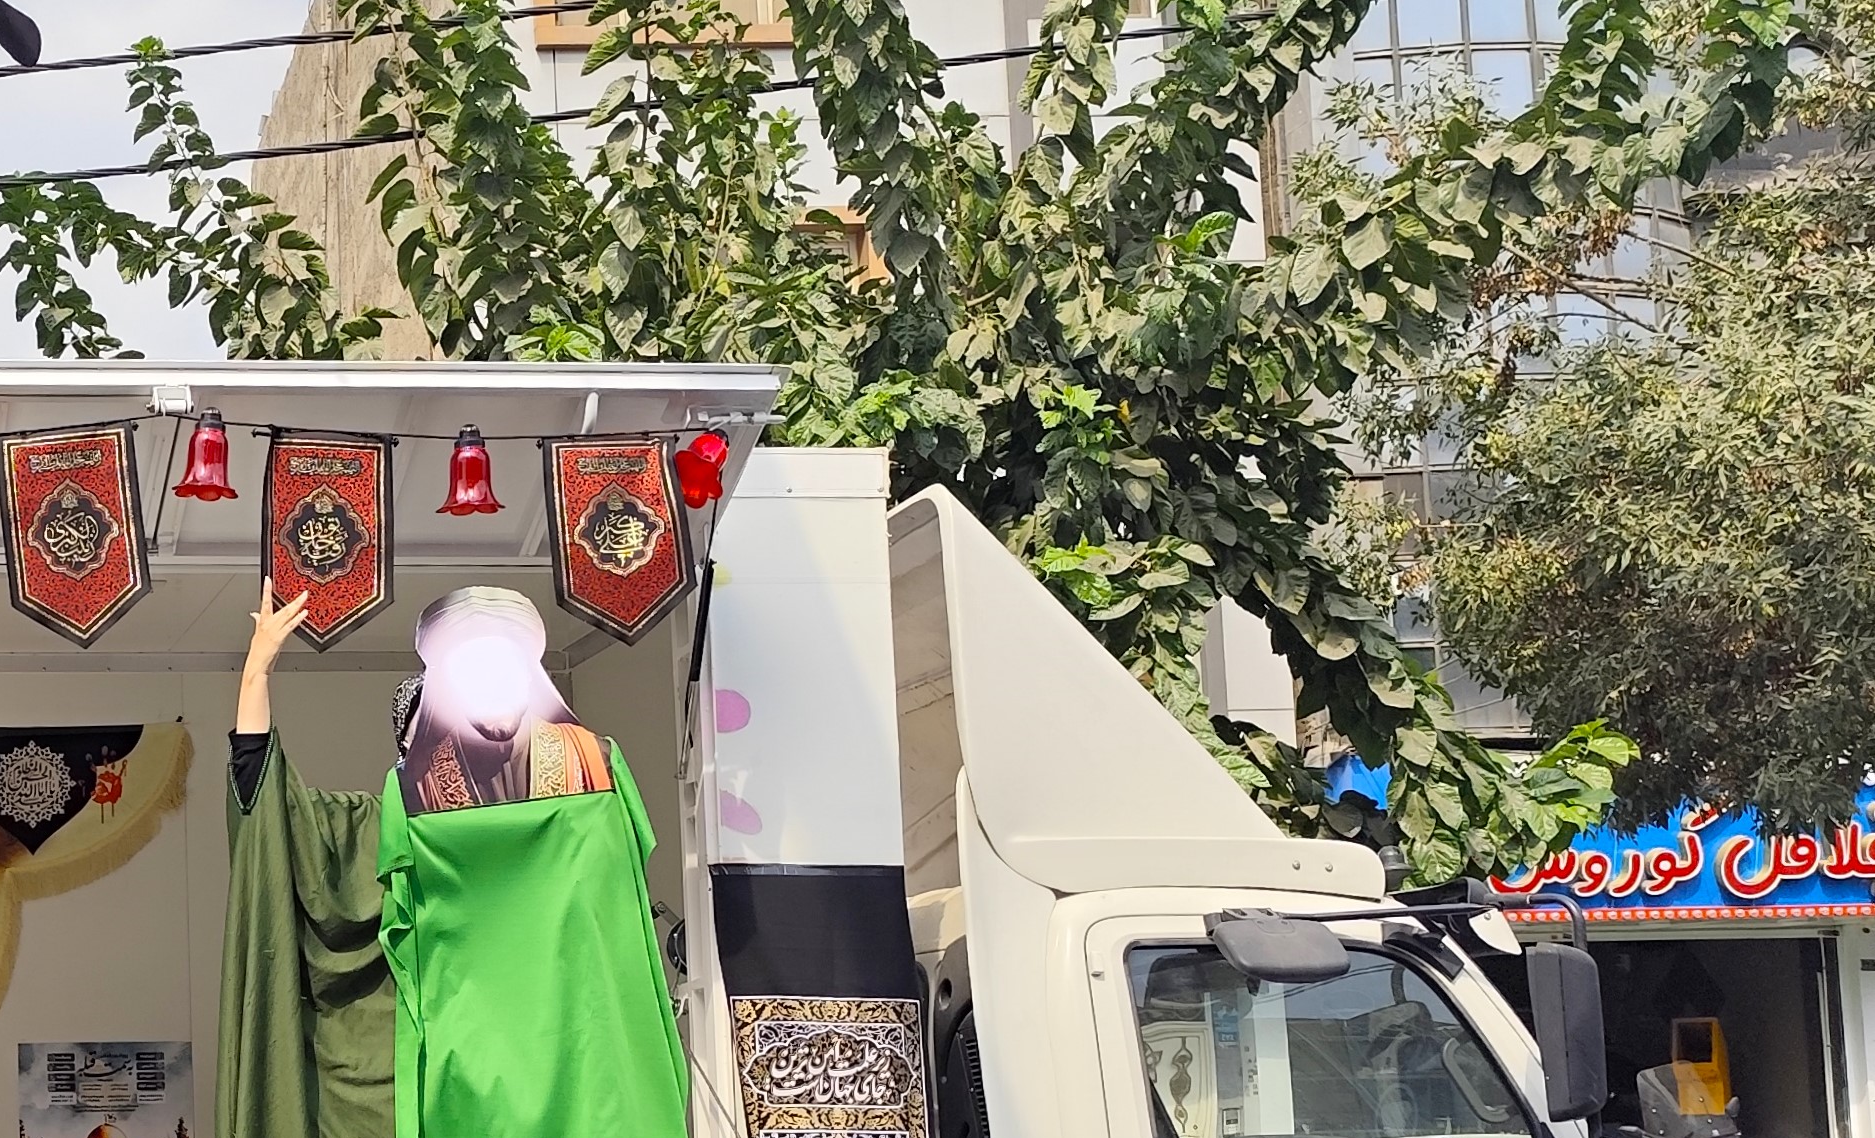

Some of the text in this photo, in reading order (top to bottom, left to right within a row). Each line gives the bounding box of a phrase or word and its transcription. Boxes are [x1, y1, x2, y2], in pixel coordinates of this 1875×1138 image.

[872, 1050, 891, 1078] زیر
[771, 1074, 886, 1104] جای جهان است
